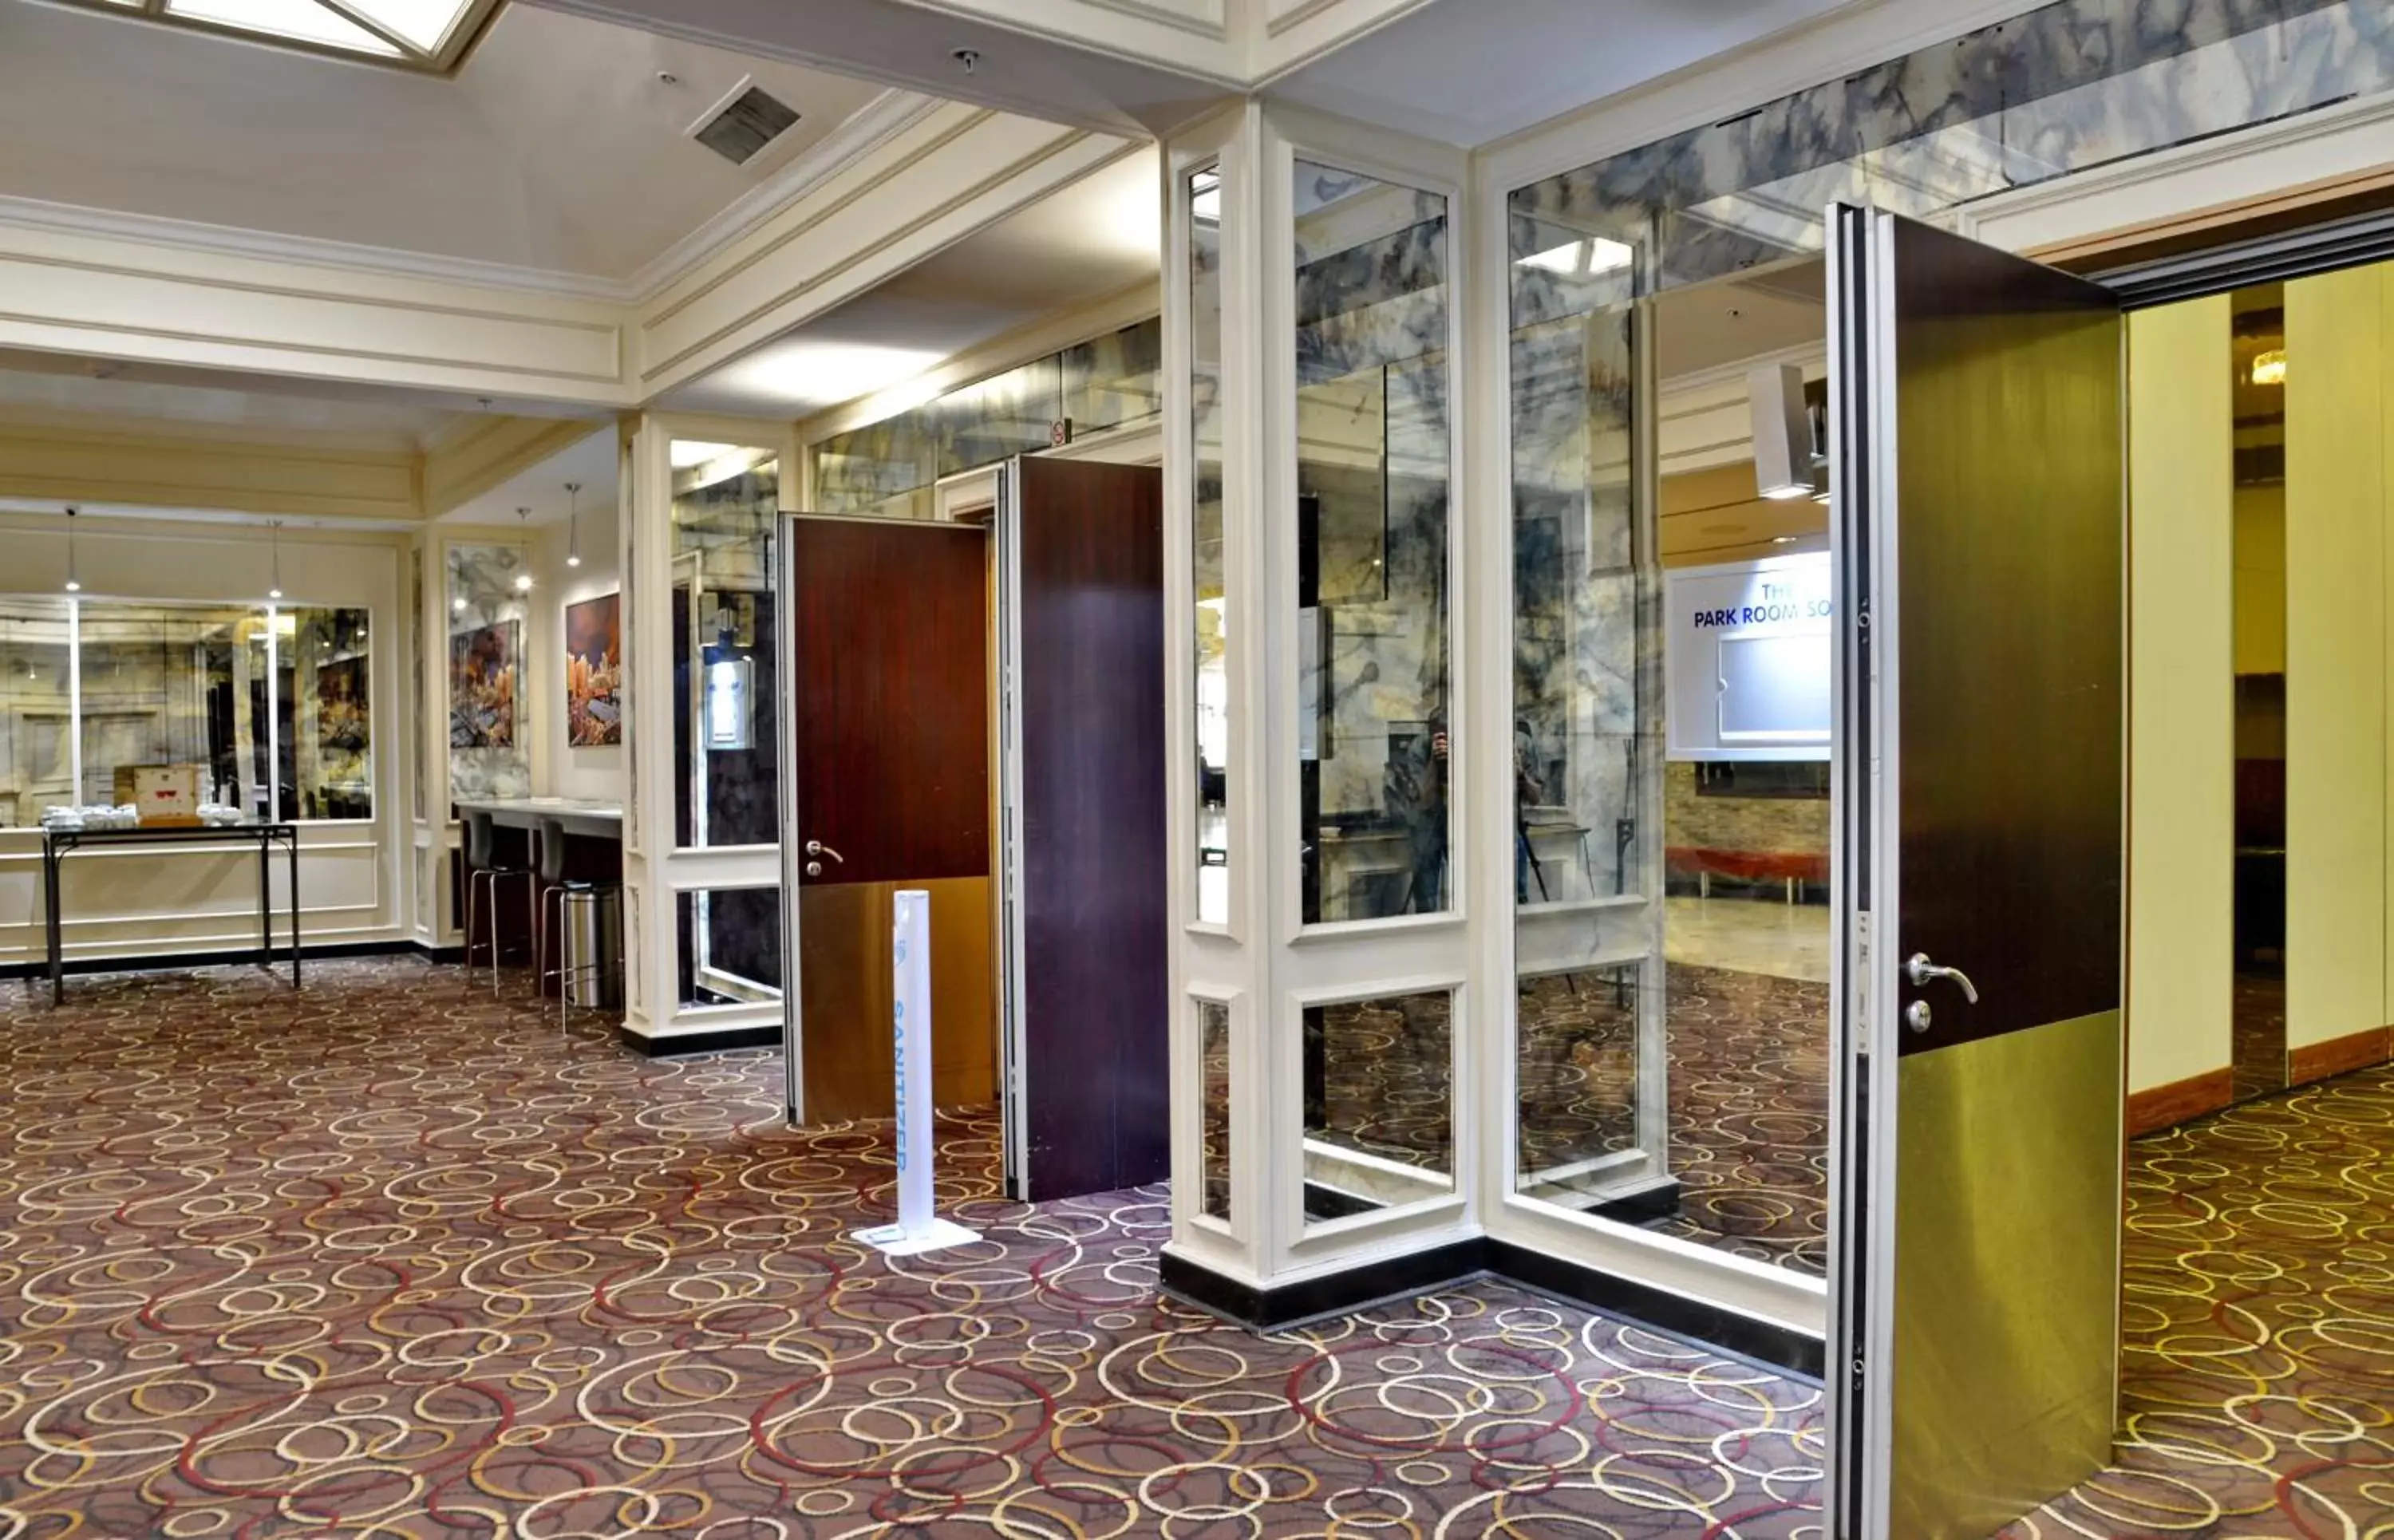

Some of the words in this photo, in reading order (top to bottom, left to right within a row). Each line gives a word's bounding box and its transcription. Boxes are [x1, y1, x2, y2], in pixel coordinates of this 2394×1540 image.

[1694, 607, 1737, 628] PARK
[1742, 604, 1798, 623] ROOM
[895, 1000, 907, 1171] SANITIZER
